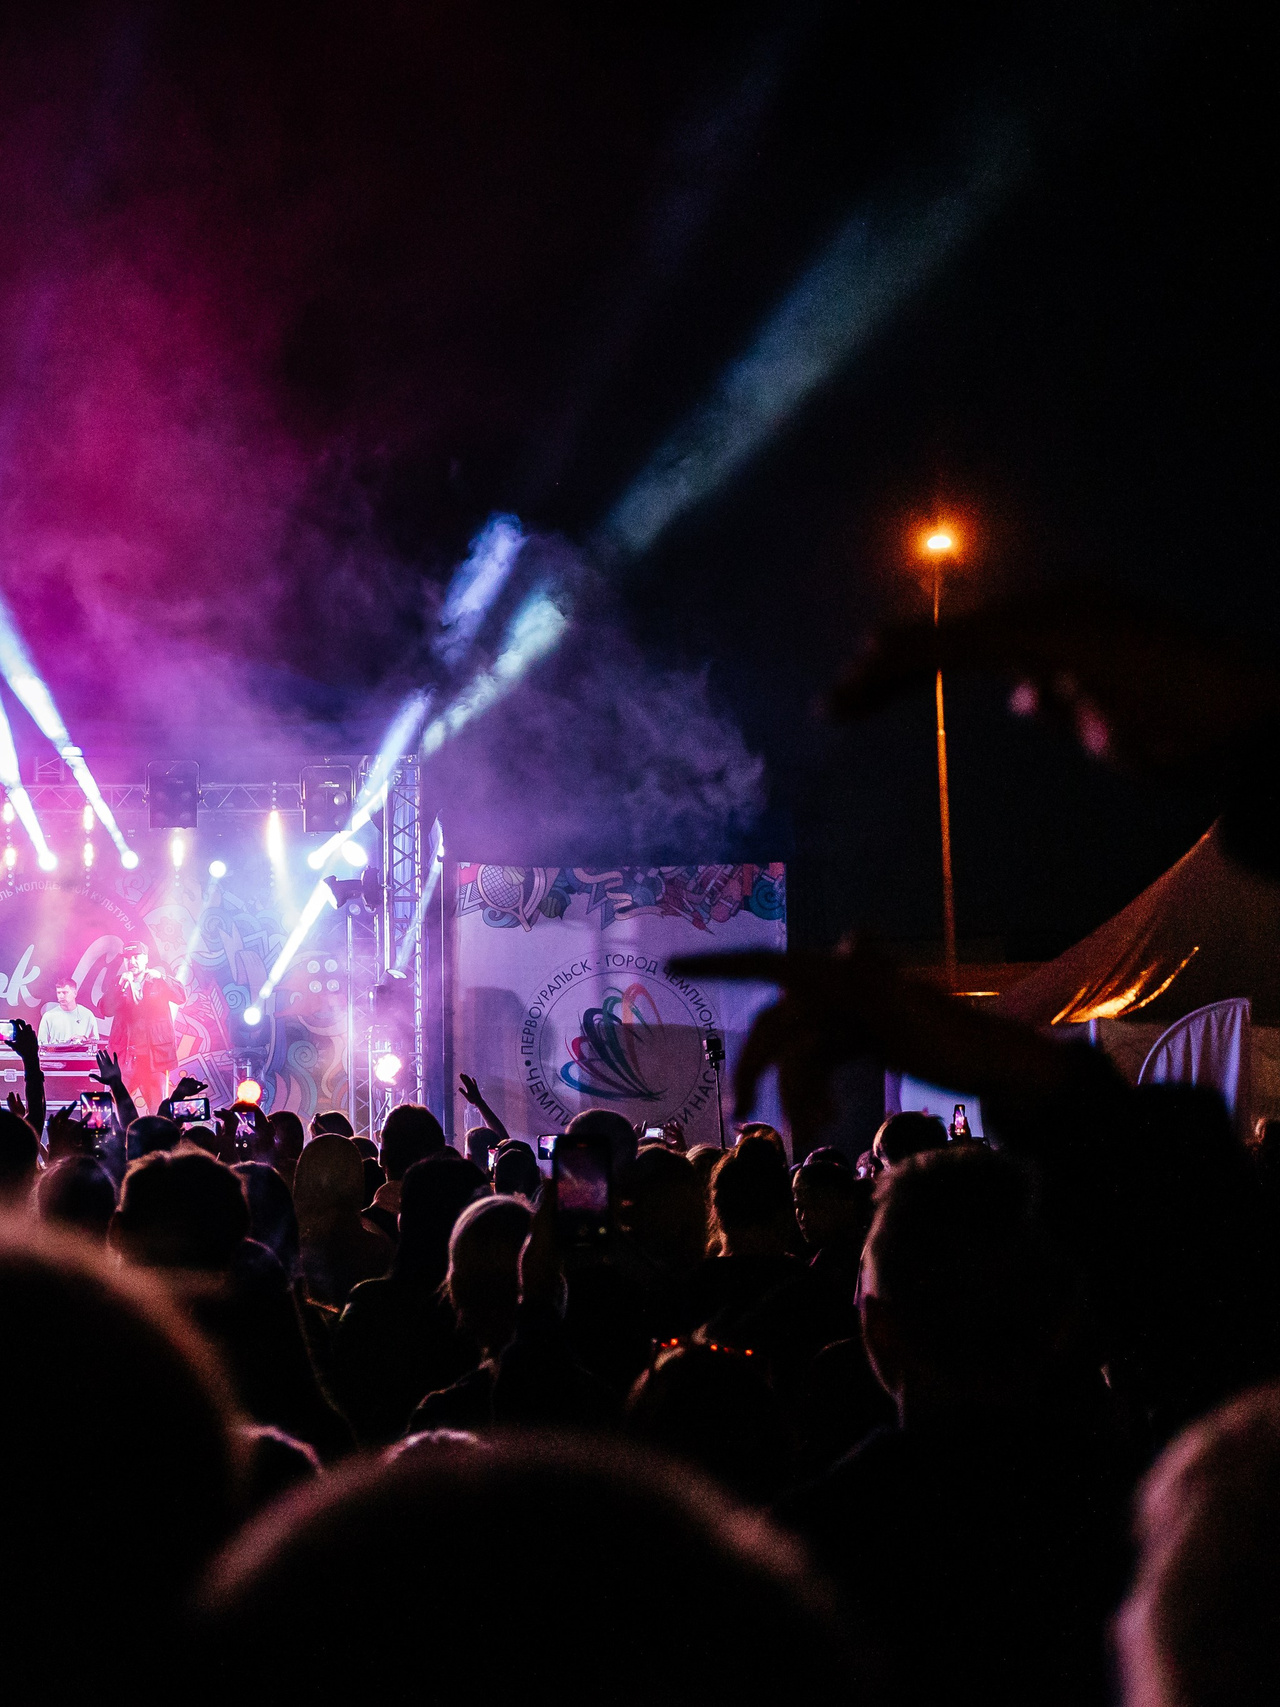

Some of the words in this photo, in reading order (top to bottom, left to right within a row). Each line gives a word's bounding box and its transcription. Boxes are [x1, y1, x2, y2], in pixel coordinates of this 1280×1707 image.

[521, 959, 593, 1055] ПЕРВОУРАЛЬСК
[605, 953, 659, 976] ГОРОД
[663, 966, 719, 1040] ЧЕМПИОН
